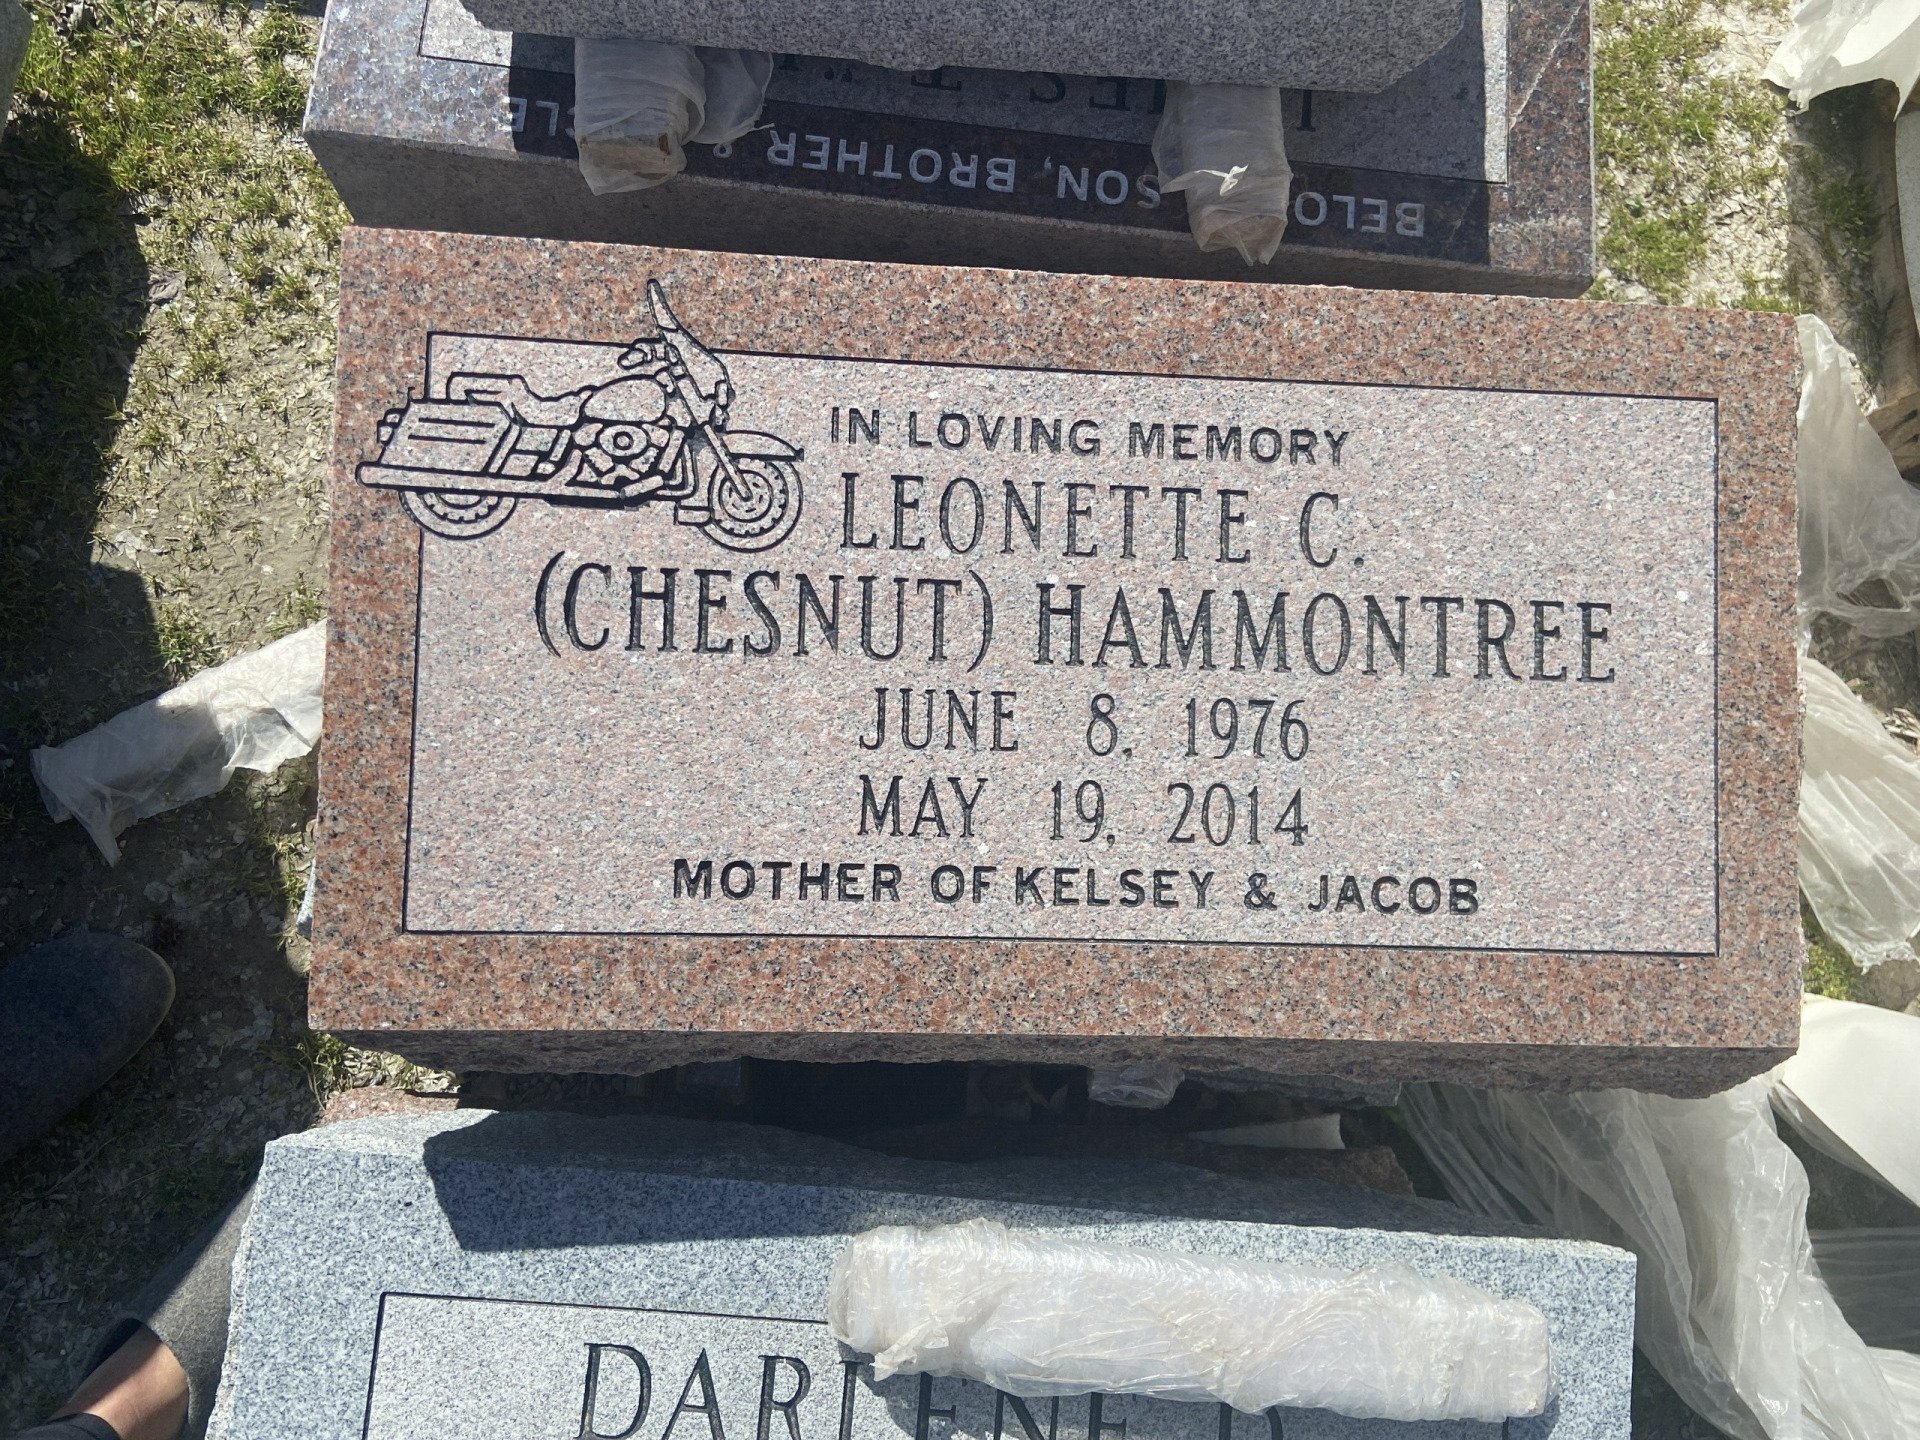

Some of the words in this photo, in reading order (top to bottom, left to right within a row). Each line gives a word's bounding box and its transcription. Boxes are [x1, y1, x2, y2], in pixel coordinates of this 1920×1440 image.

[766, 129, 1017, 193] BROTHER
[831, 406, 881, 445] IN
[908, 410, 1100, 457] LOVING
[1128, 421, 1349, 467] MEMORY
[839, 471, 1251, 564] LEONETTE
[1299, 491, 1366, 569] C.
[534, 550, 995, 672] (CHESNUT)
[1033, 582, 1616, 684] HAMMONTREE
[858, 687, 1019, 753] JUNE
[1185, 696, 1310, 762] 1976
[857, 774, 989, 838] MAY
[1049, 778, 1117, 848] 19,
[1166, 781, 1309, 847] 2014
[673, 858, 902, 902] MOTHER
[930, 864, 998, 903] OF
[1015, 866, 1216, 909] KELSEY
[1243, 872, 1278, 911] &
[1307, 874, 1480, 917] JACOB
